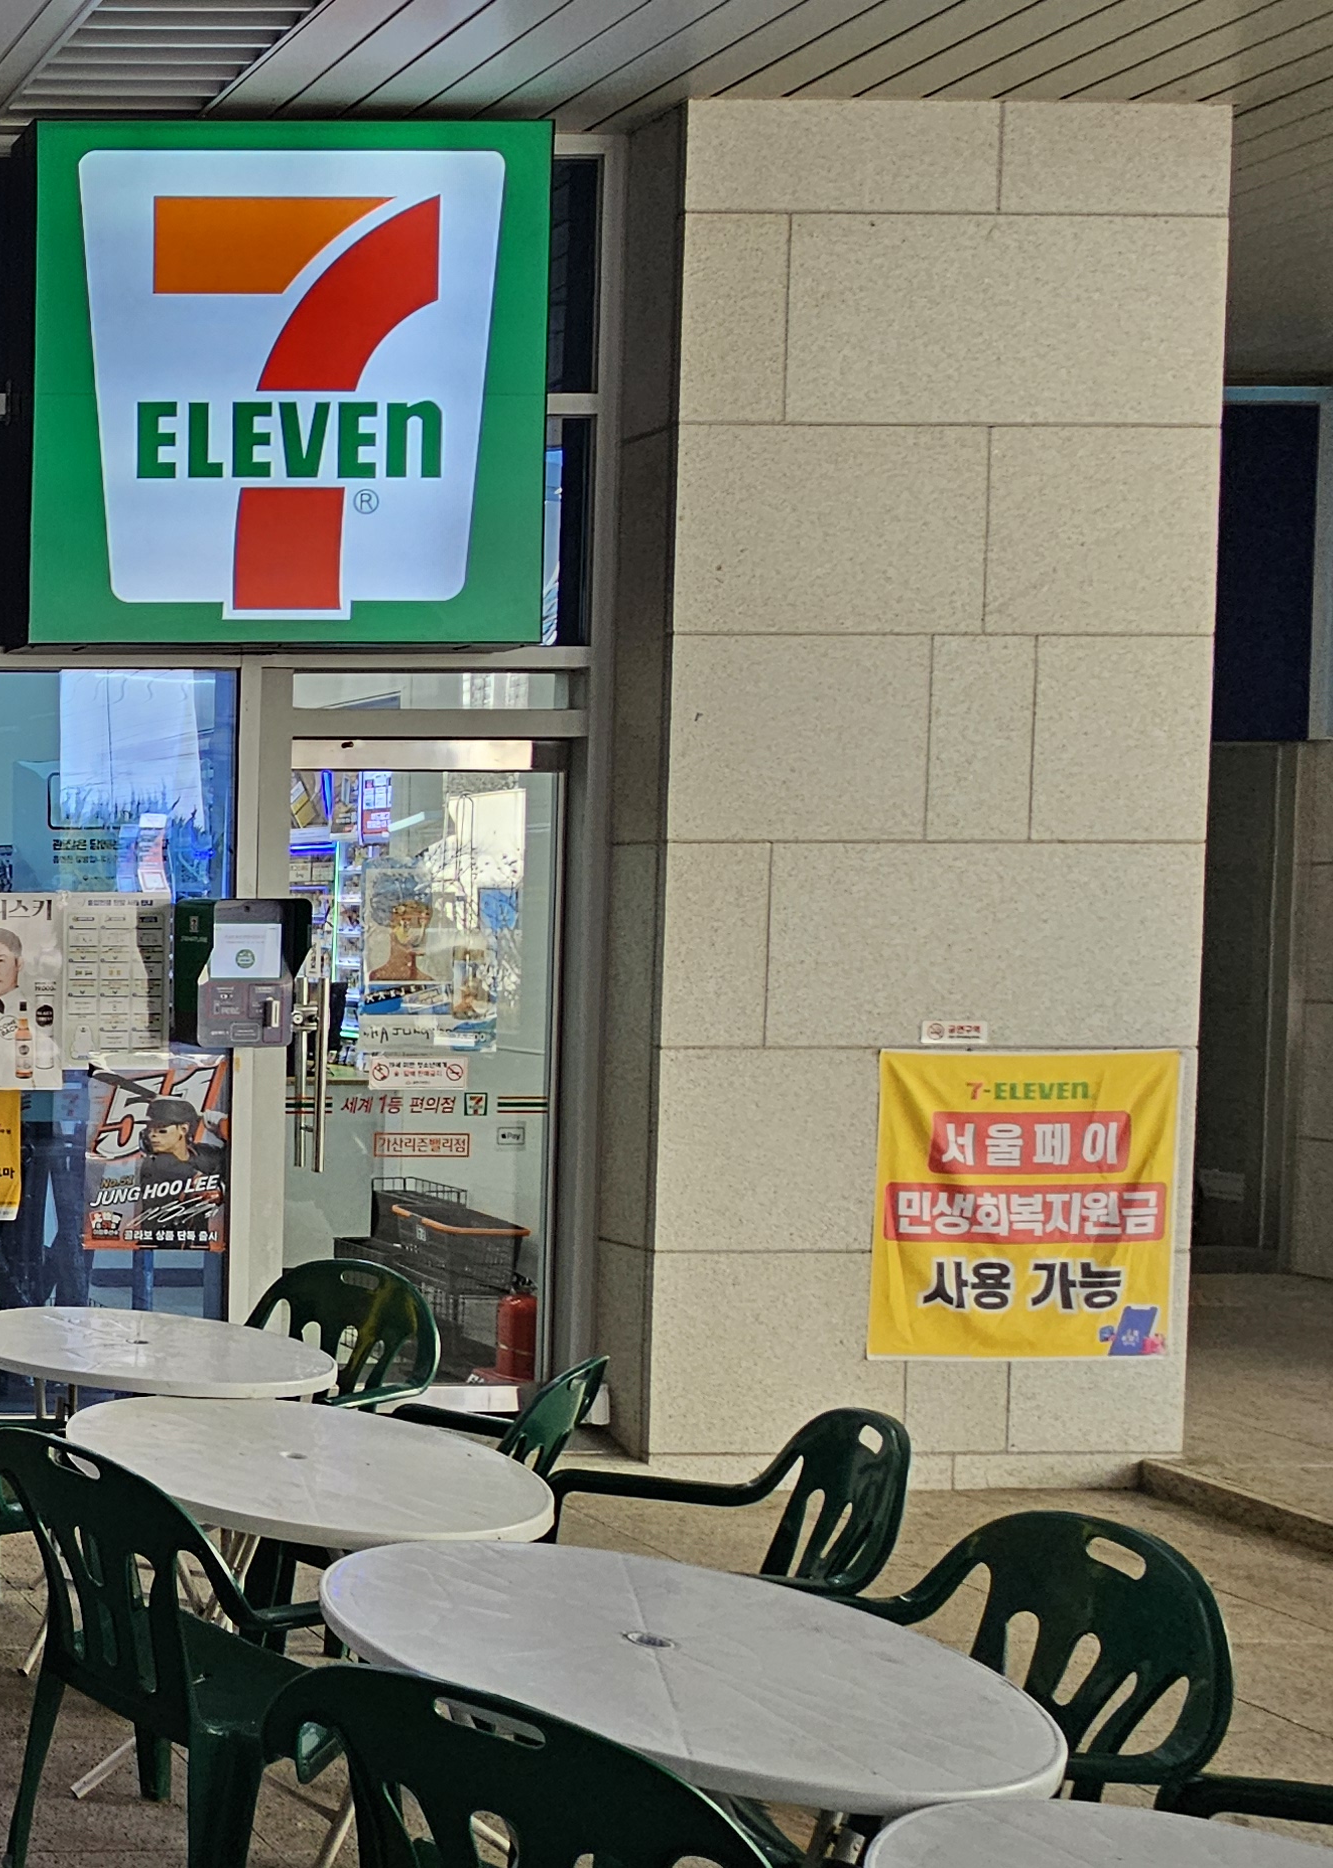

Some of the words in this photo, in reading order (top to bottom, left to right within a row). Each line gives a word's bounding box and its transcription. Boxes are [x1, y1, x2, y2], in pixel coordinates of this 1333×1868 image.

[340, 1096, 372, 1114] 세계
[408, 1095, 457, 1115] 편의점
[89, 1185, 142, 1208] JUNG
[142, 1179, 184, 1201] HOO
[183, 1173, 221, 1194] LEE
[897, 1190, 1159, 1237] 민생회복지원금
[155, 1229, 176, 1241] 상품
[921, 1260, 1012, 1311] 사용
[1030, 1260, 1123, 1311] 가능
